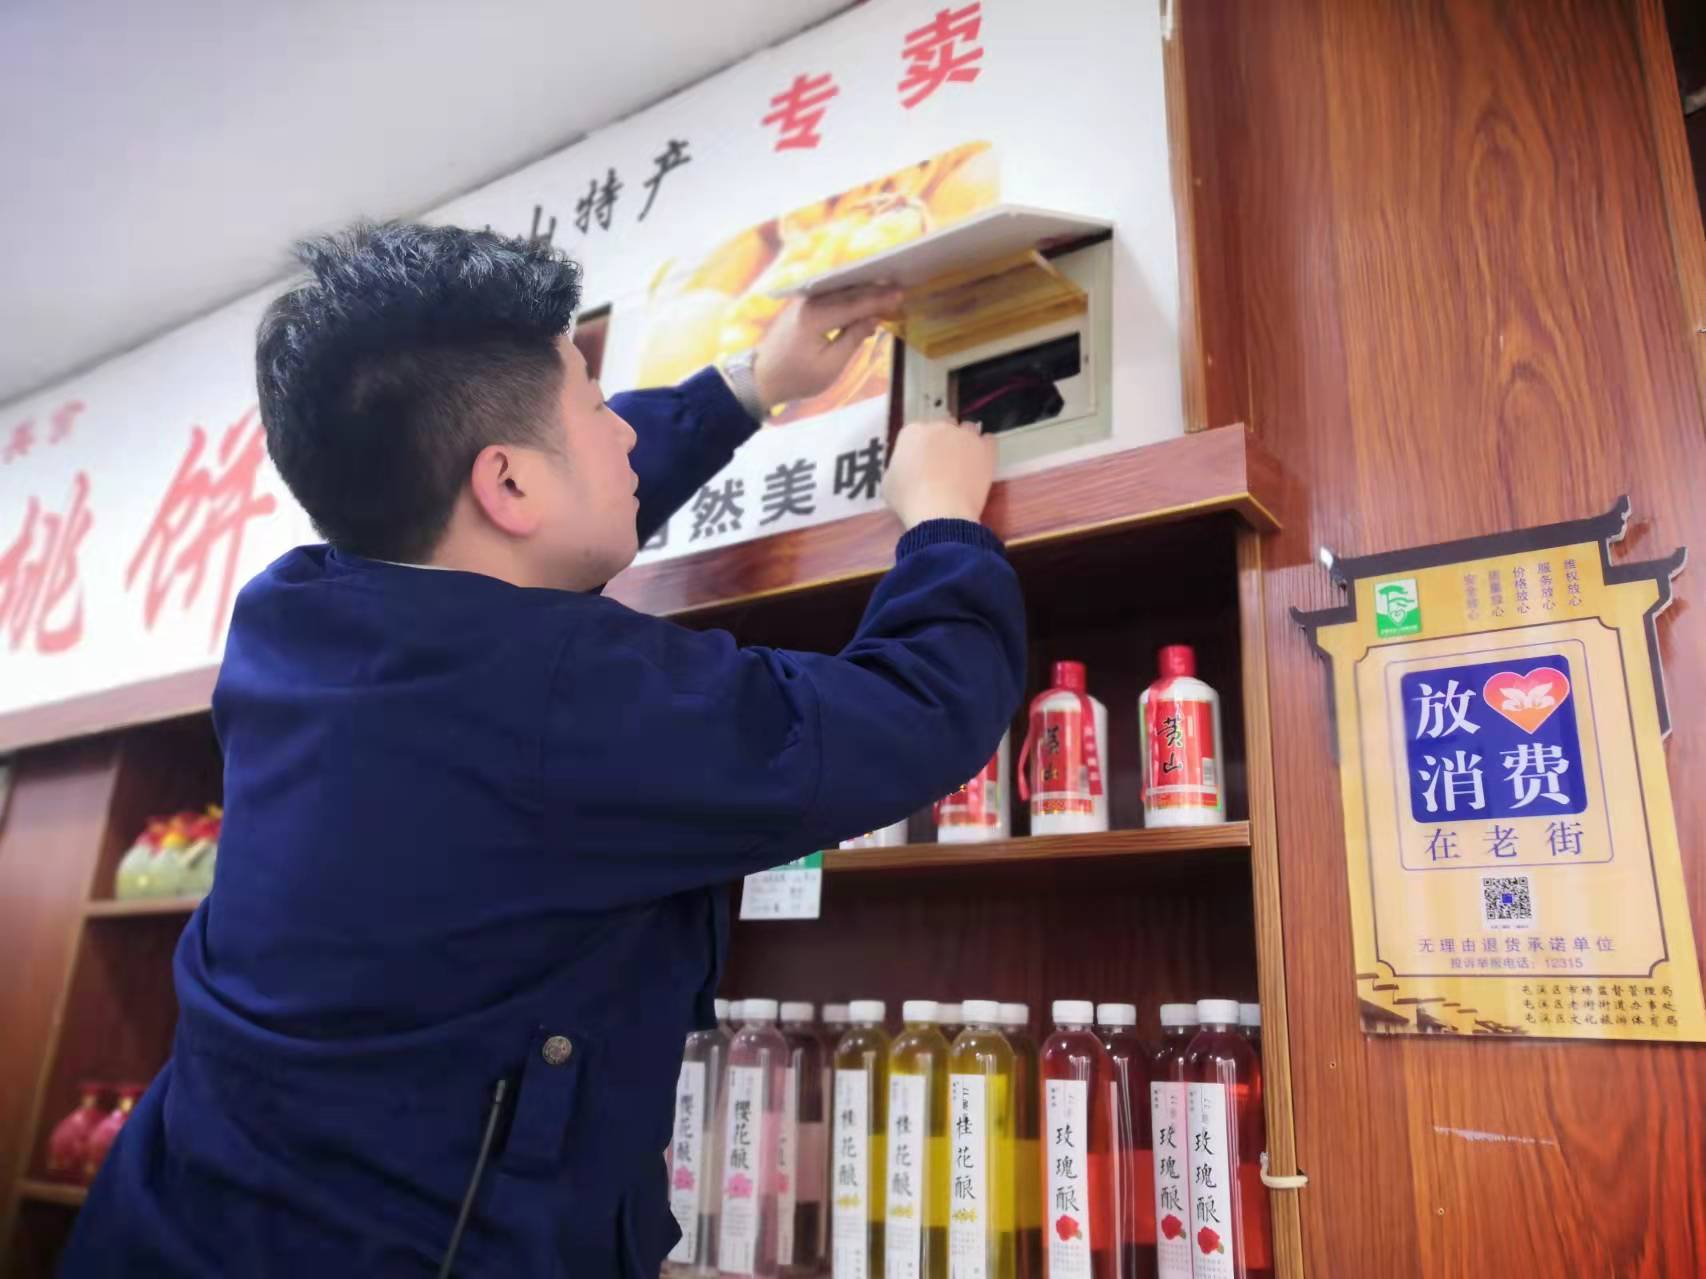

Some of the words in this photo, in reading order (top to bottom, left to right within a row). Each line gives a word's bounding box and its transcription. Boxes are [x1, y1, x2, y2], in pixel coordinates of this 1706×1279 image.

[761, 2, 983, 153] 专卖
[641, 436, 886, 551] 然美味
[1513, 566, 1531, 614] 价格放心
[1538, 561, 1556, 610] 服务放心
[1411, 679, 1481, 740] 放
[1417, 743, 1571, 812] 消费
[1424, 821, 1584, 862] 在老街
[1418, 936, 1616, 953] 无理由退货承诺单位
[890, 1115, 914, 1198] 桂花酿
[953, 1116, 977, 1201] 桂花酿
[1055, 1123, 1080, 1213] 玫瑰酿
[1159, 1123, 1184, 1213] 玫瑰酿
[1194, 1131, 1221, 1225] 玫瑰酿
